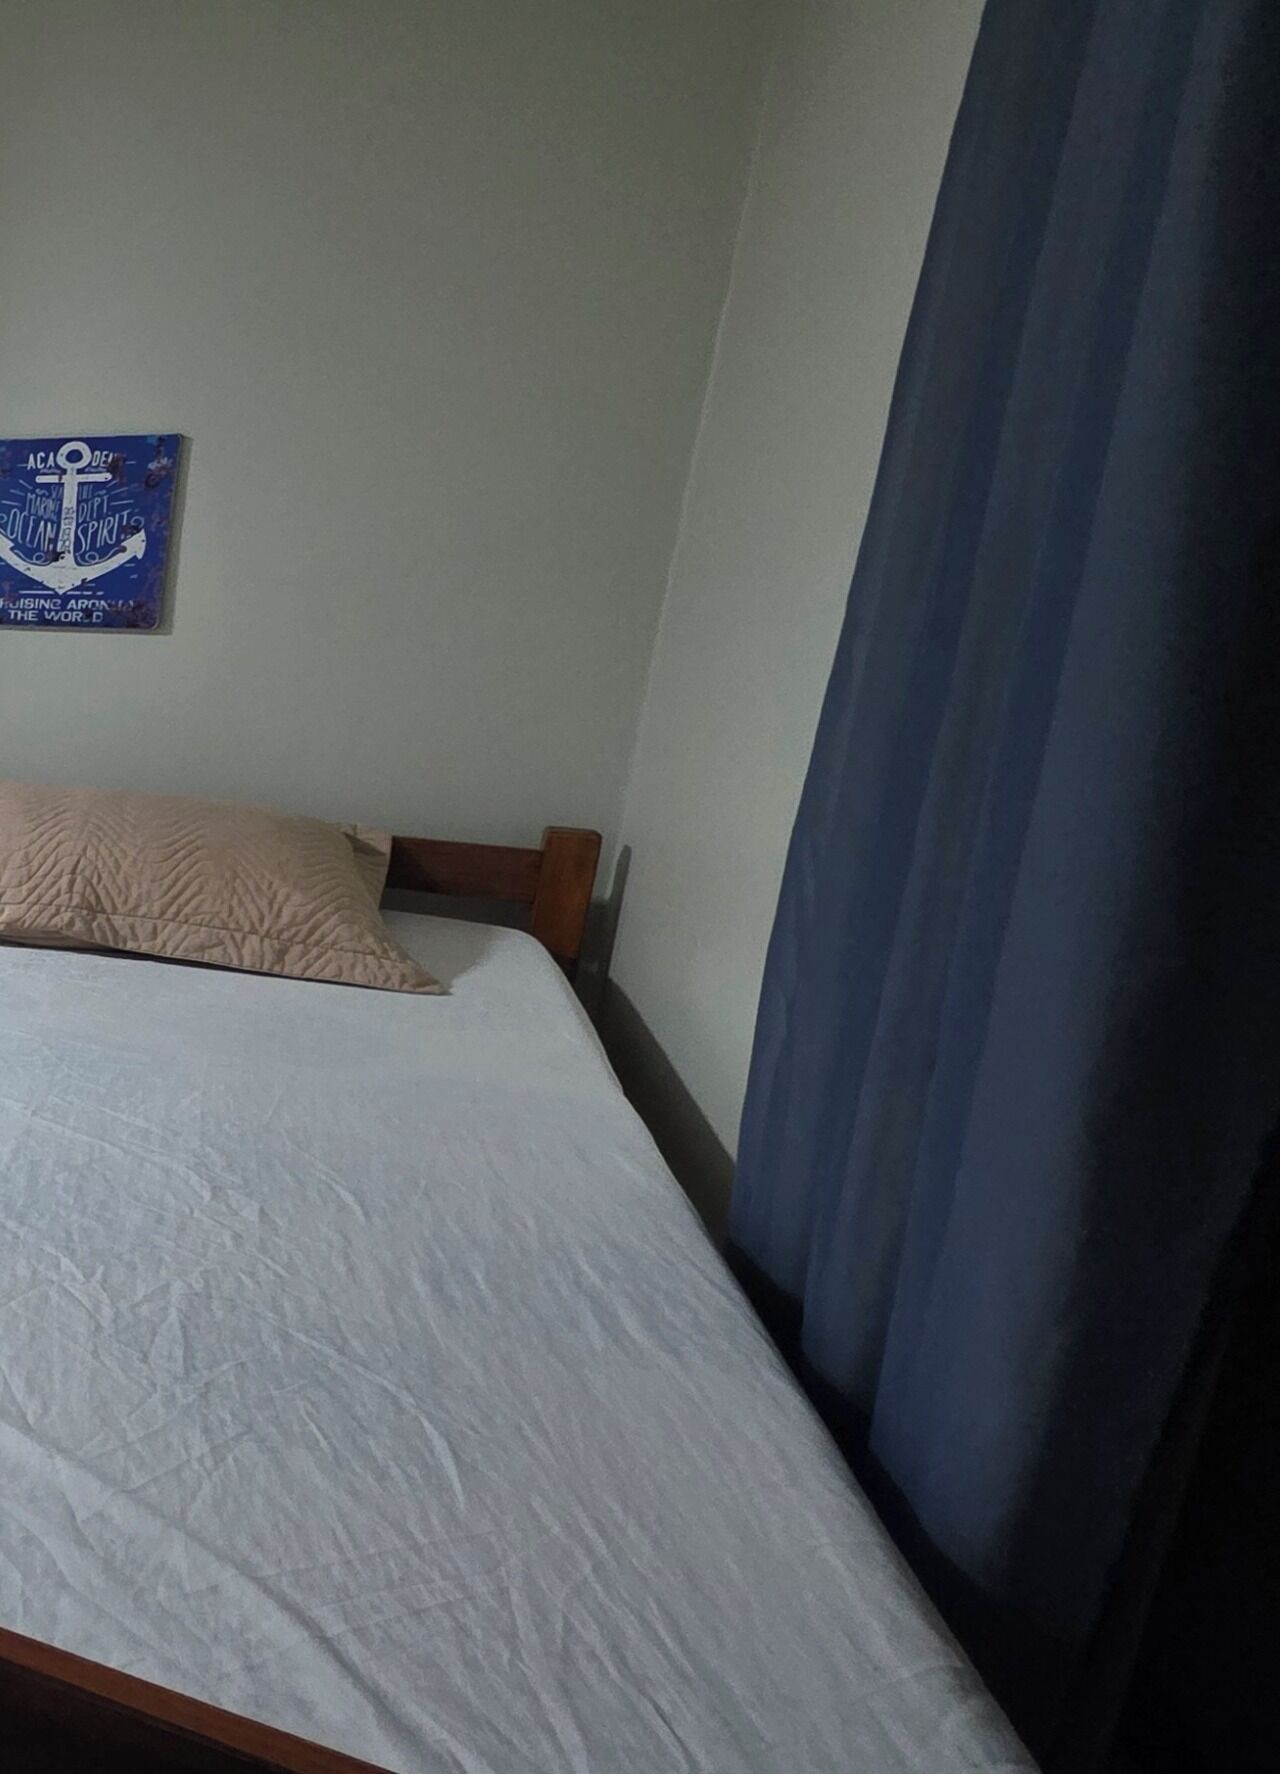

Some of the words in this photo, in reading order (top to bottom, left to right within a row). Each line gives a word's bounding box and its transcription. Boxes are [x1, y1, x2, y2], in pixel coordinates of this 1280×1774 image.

[27, 450, 119, 470] ACADE
[7, 508, 57, 552] OCEAN
[7, 609, 39, 621] THE
